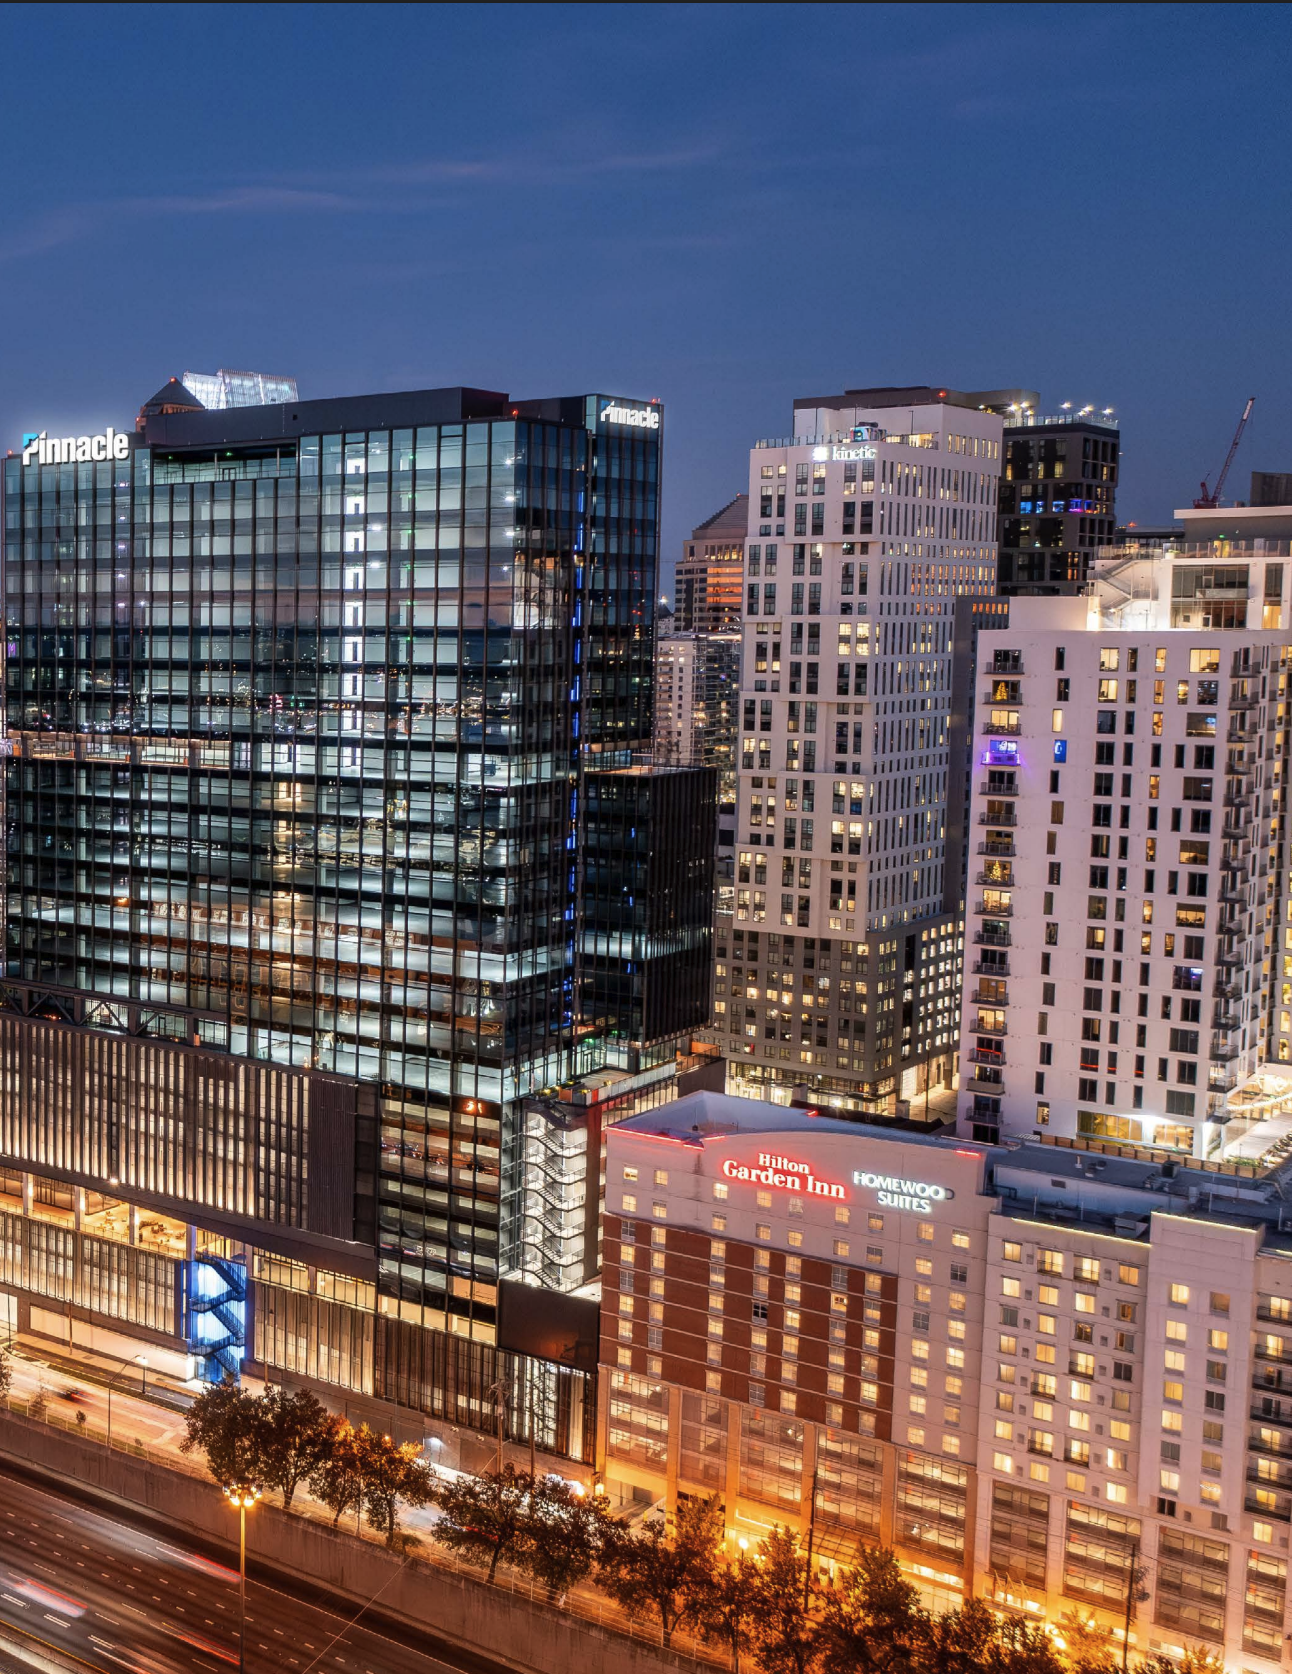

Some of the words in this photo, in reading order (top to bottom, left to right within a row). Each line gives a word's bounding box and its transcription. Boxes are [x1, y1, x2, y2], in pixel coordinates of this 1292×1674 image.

[600, 400, 659, 429] Pinnacle
[23, 427, 129, 465] Pinnacle
[832, 445, 877, 460] kinetic
[758, 1152, 811, 1174] Hilton
[722, 1160, 801, 1190] Garden
[806, 1174, 846, 1199] Inn
[853, 1170, 955, 1200] HOMEWOOD
[877, 1190, 931, 1213] SUITES
